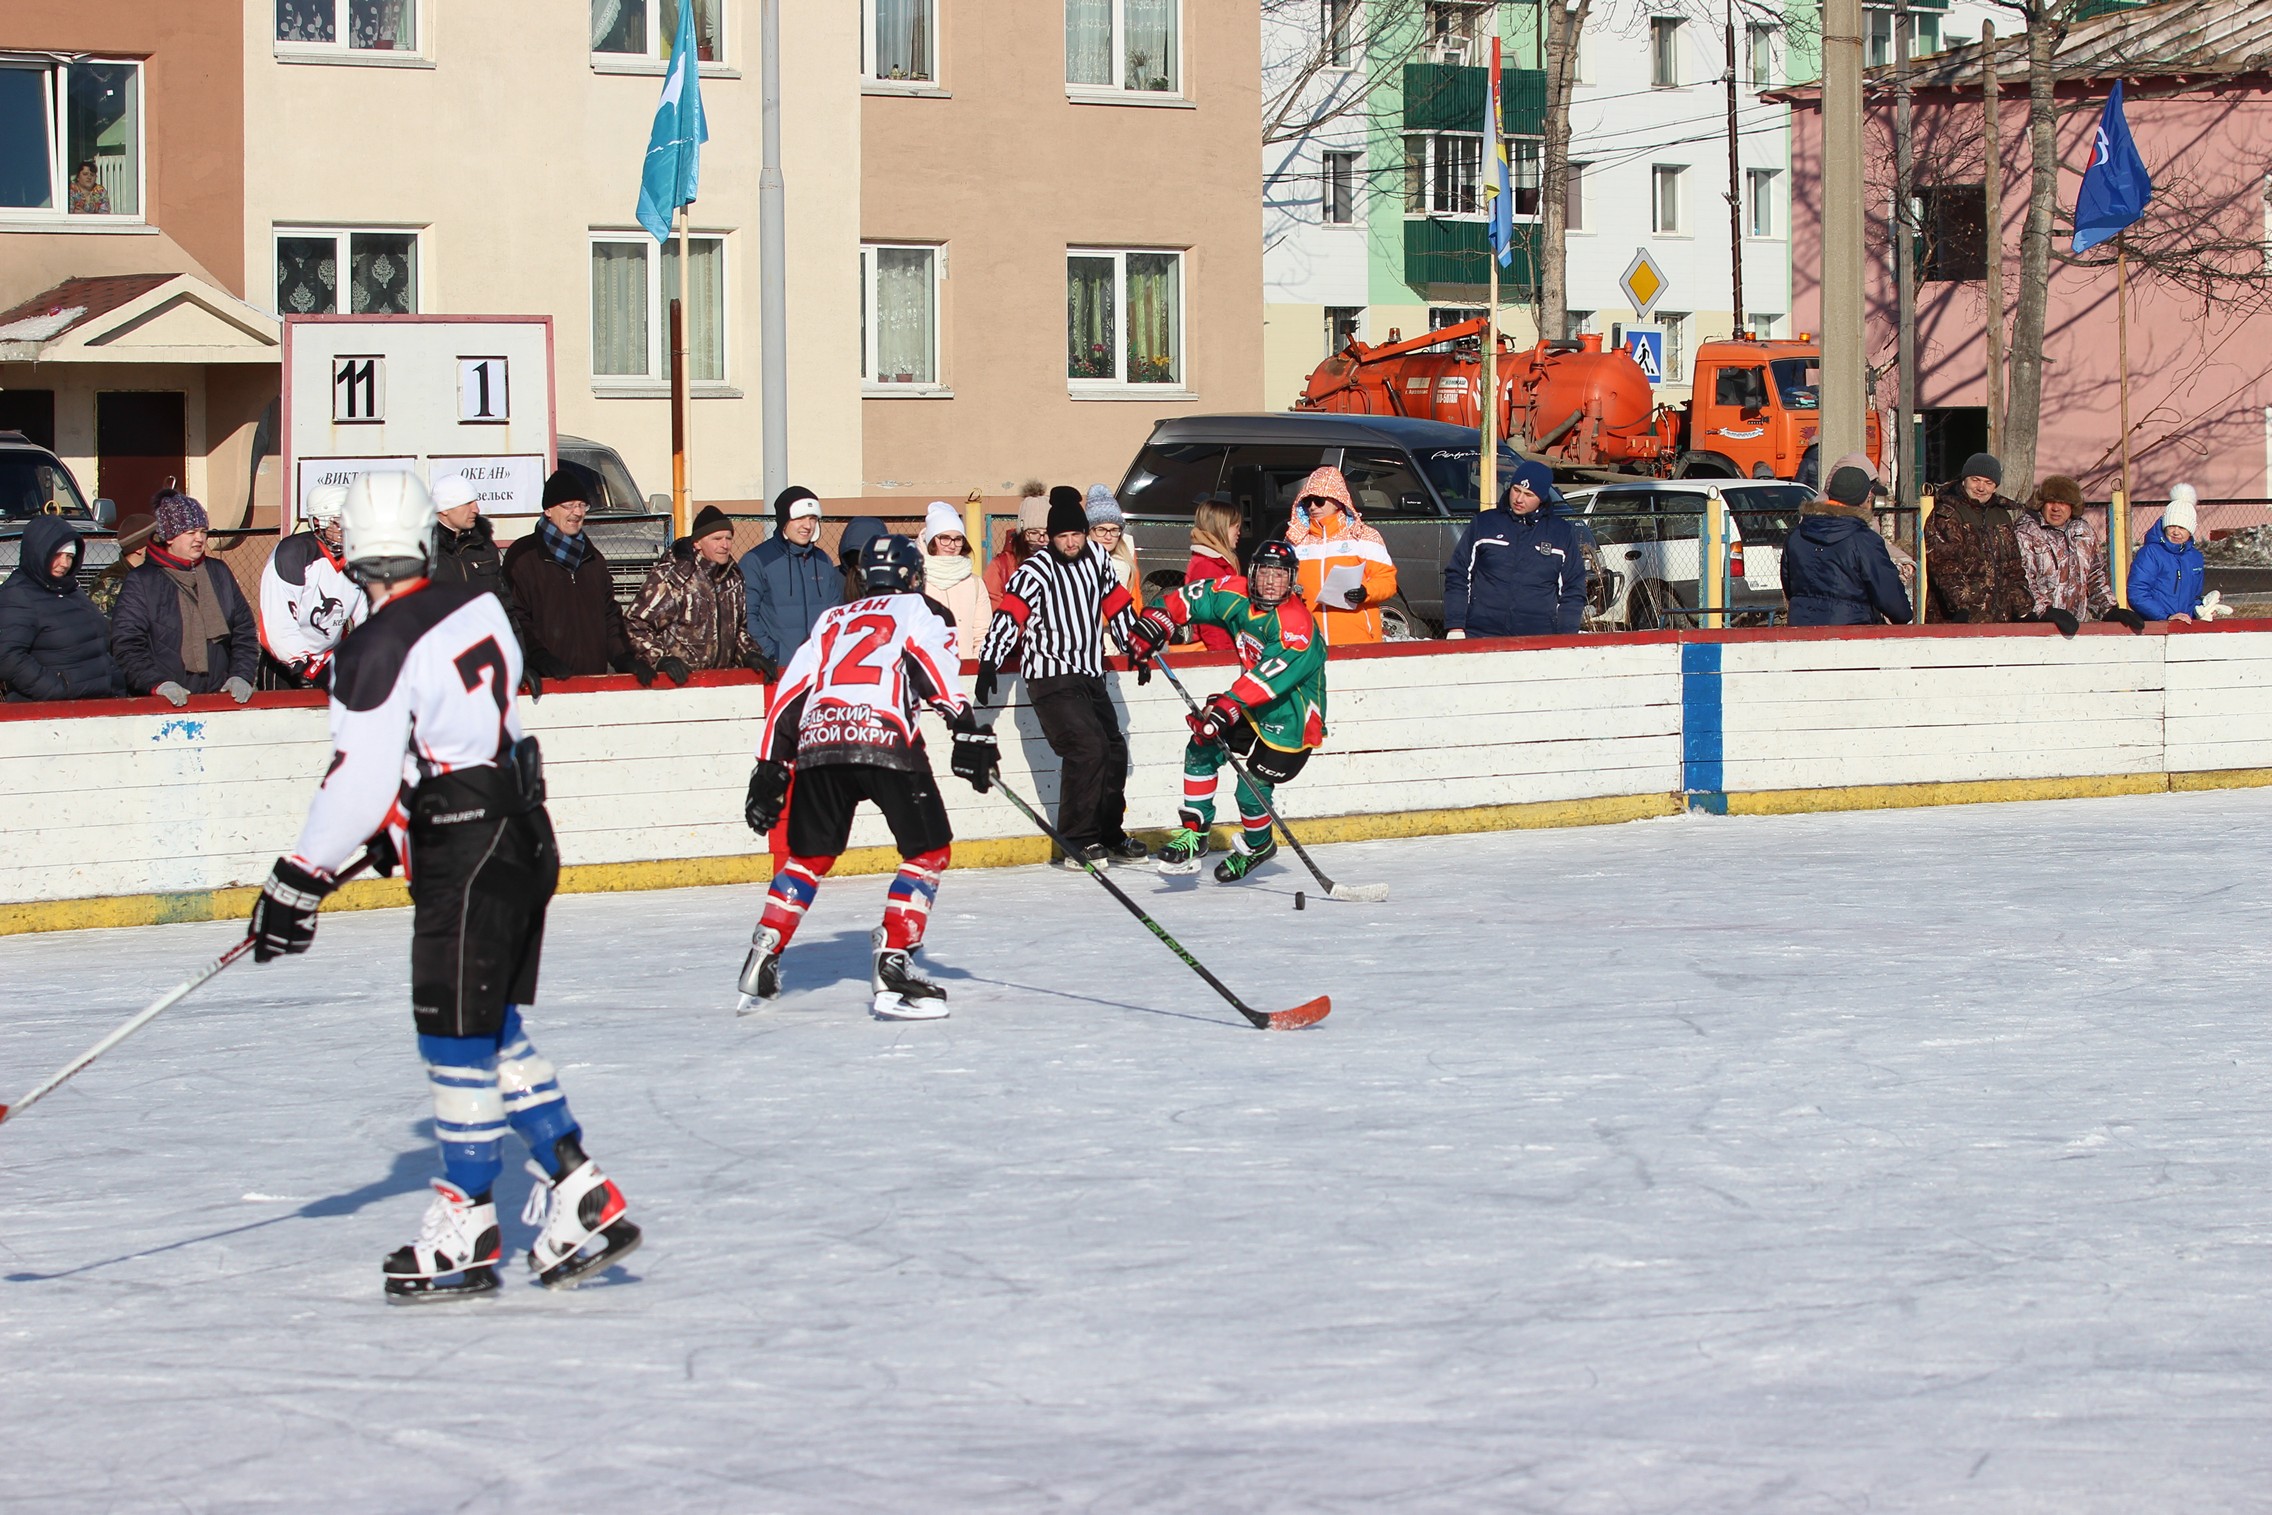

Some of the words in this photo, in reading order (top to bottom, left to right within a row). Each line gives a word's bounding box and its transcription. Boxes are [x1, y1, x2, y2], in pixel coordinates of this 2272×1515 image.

[337, 360, 375, 417] 11
[472, 361, 495, 417] 1
[317, 471, 359, 485] «ВИКТ
[814, 613, 897, 696] 12
[1260, 657, 1288, 678] 17
[453, 634, 509, 760] 7
[844, 725, 898, 746] ОКРУГ
[1256, 763, 1287, 778] CCM
[431, 808, 486, 825] BAUER
